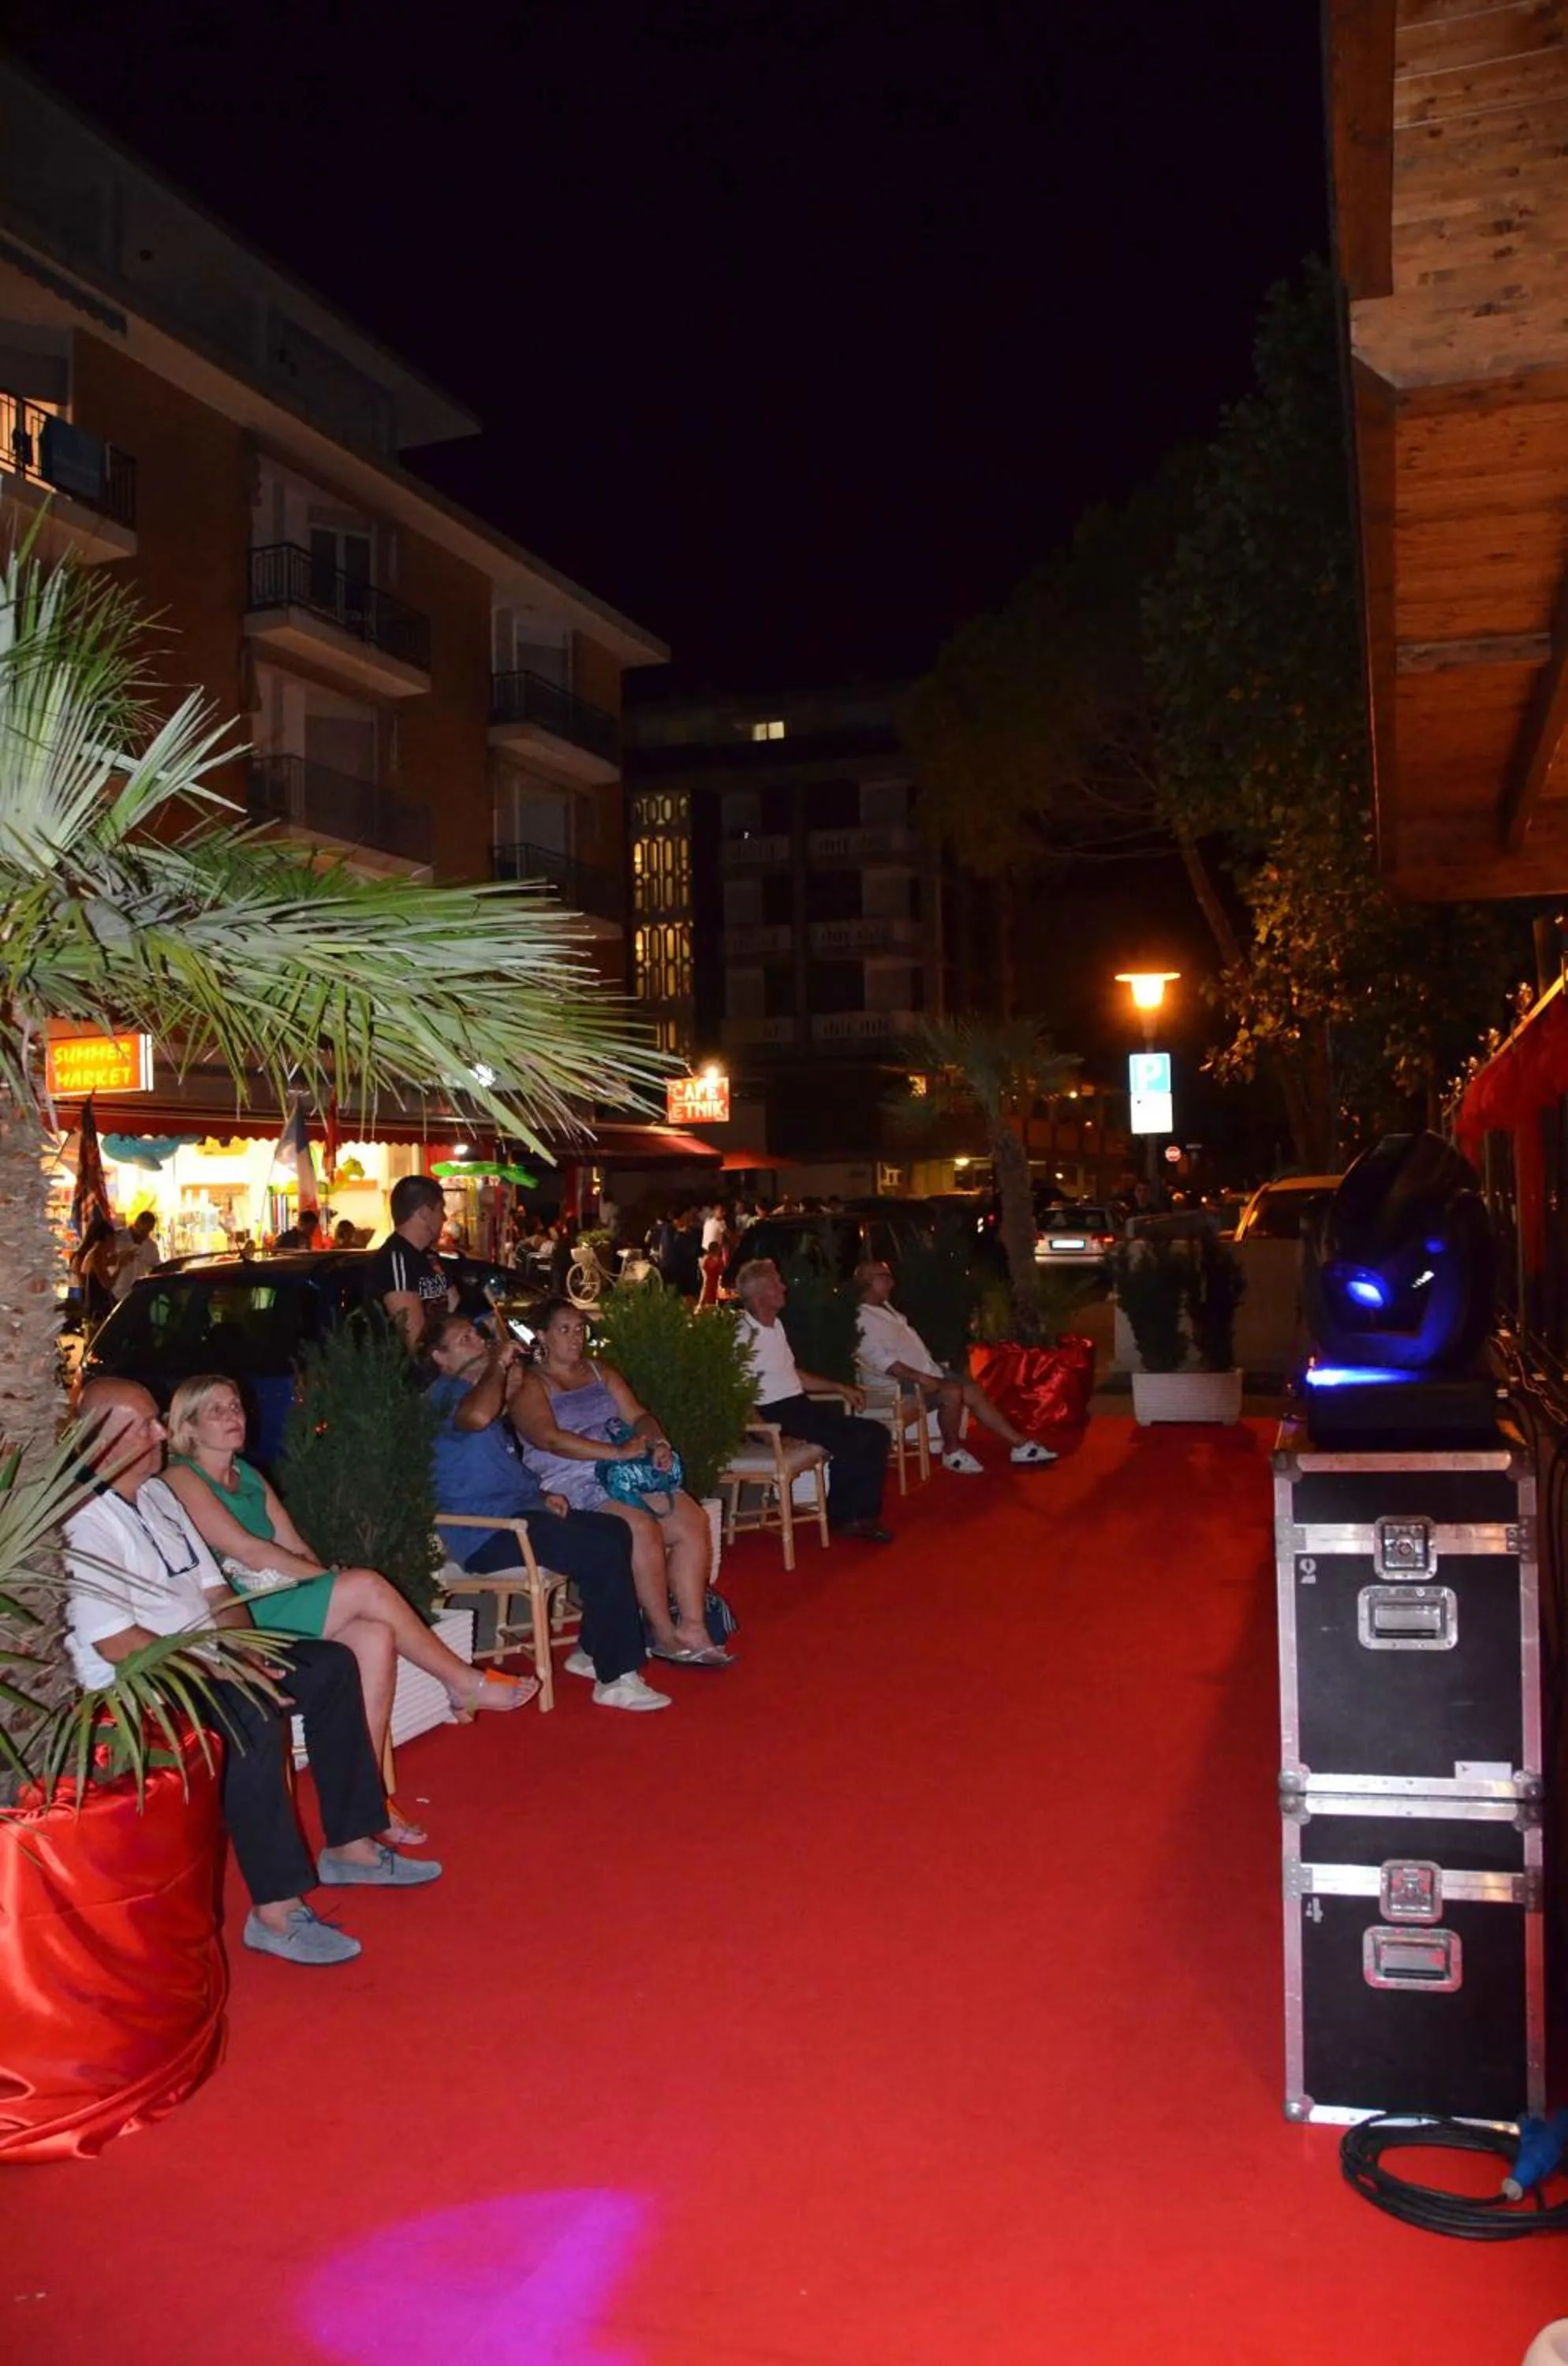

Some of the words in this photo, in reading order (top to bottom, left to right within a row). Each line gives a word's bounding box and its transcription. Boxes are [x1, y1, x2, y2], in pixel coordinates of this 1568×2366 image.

[53, 1041, 131, 1065] SUMMER
[55, 1066, 130, 1088] MARKET
[1137, 1056, 1163, 1090] P
[671, 1100, 724, 1118] ETNIK
